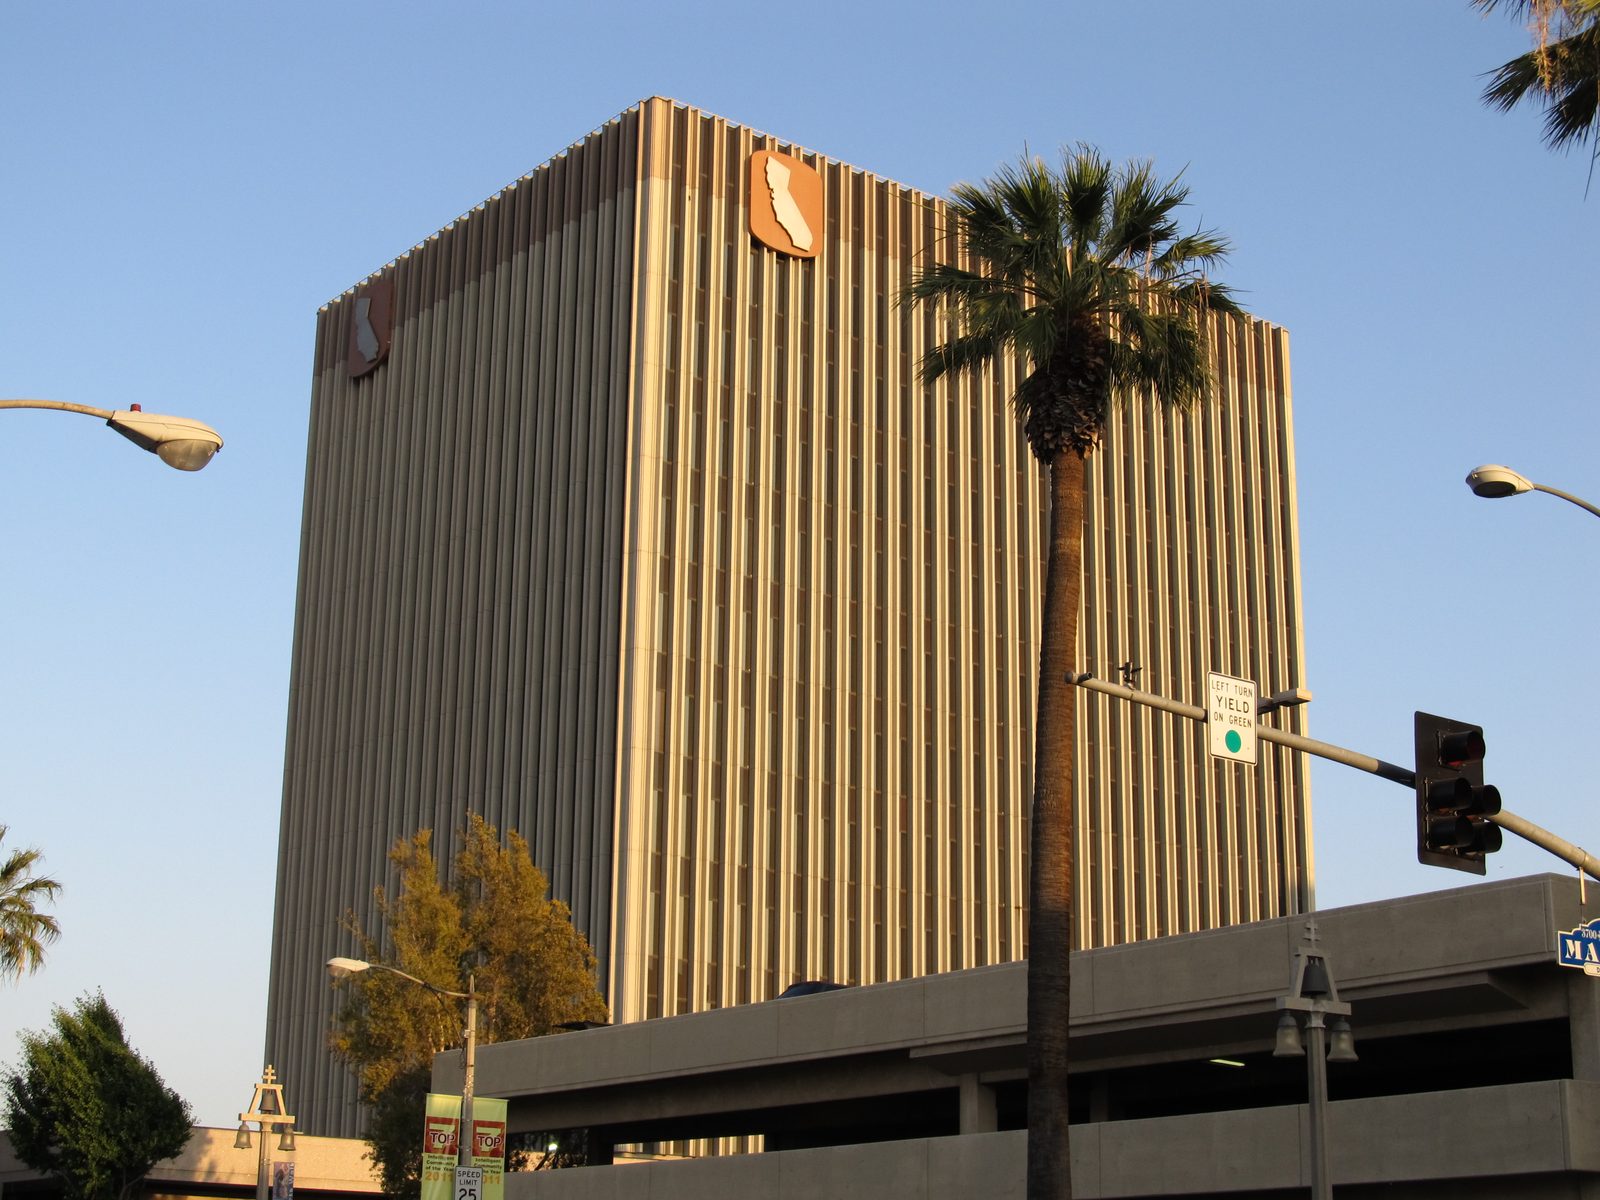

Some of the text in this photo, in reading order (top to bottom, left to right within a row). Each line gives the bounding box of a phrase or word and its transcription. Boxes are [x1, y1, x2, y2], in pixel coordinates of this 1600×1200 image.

[1212, 680, 1253, 698] LEFT TURN
[1216, 695, 1249, 713] YIELD
[1214, 711, 1252, 728] ON GREEN
[430, 1132, 455, 1144] TOP
[477, 1136, 501, 1147] TOP
[426, 1171, 453, 1181] 2011
[457, 1170, 480, 1178] SPEED
[483, 1174, 500, 1184] 011
[458, 1188, 477, 1200] 25
